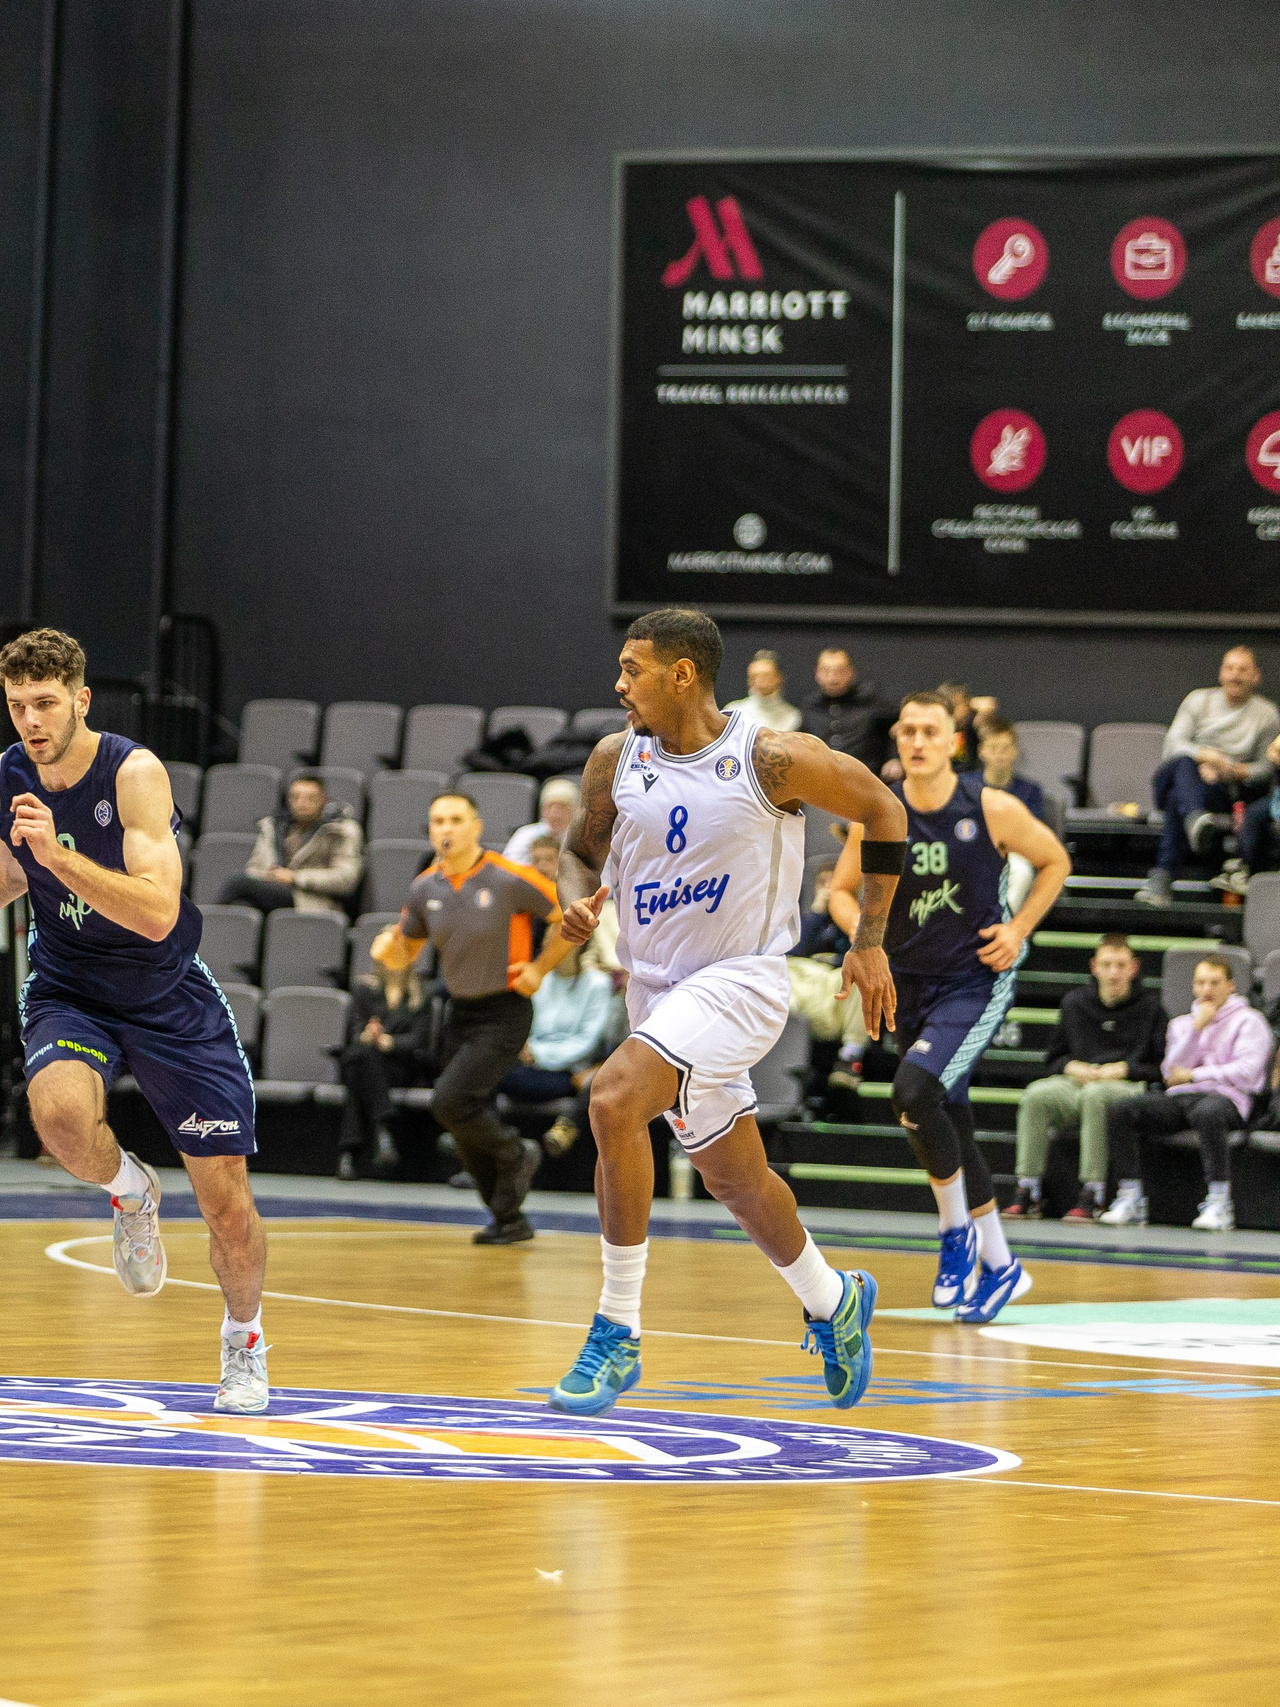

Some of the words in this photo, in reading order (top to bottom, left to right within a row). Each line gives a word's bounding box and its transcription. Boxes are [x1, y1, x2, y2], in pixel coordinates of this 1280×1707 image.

[683, 290, 850, 321] MARRIOTT
[682, 324, 784, 354] MINSK
[657, 384, 723, 404] TRAVEL
[1121, 435, 1172, 467] VIP
[666, 805, 688, 854] 8
[911, 841, 948, 876] 38
[634, 873, 730, 925] Enisey
